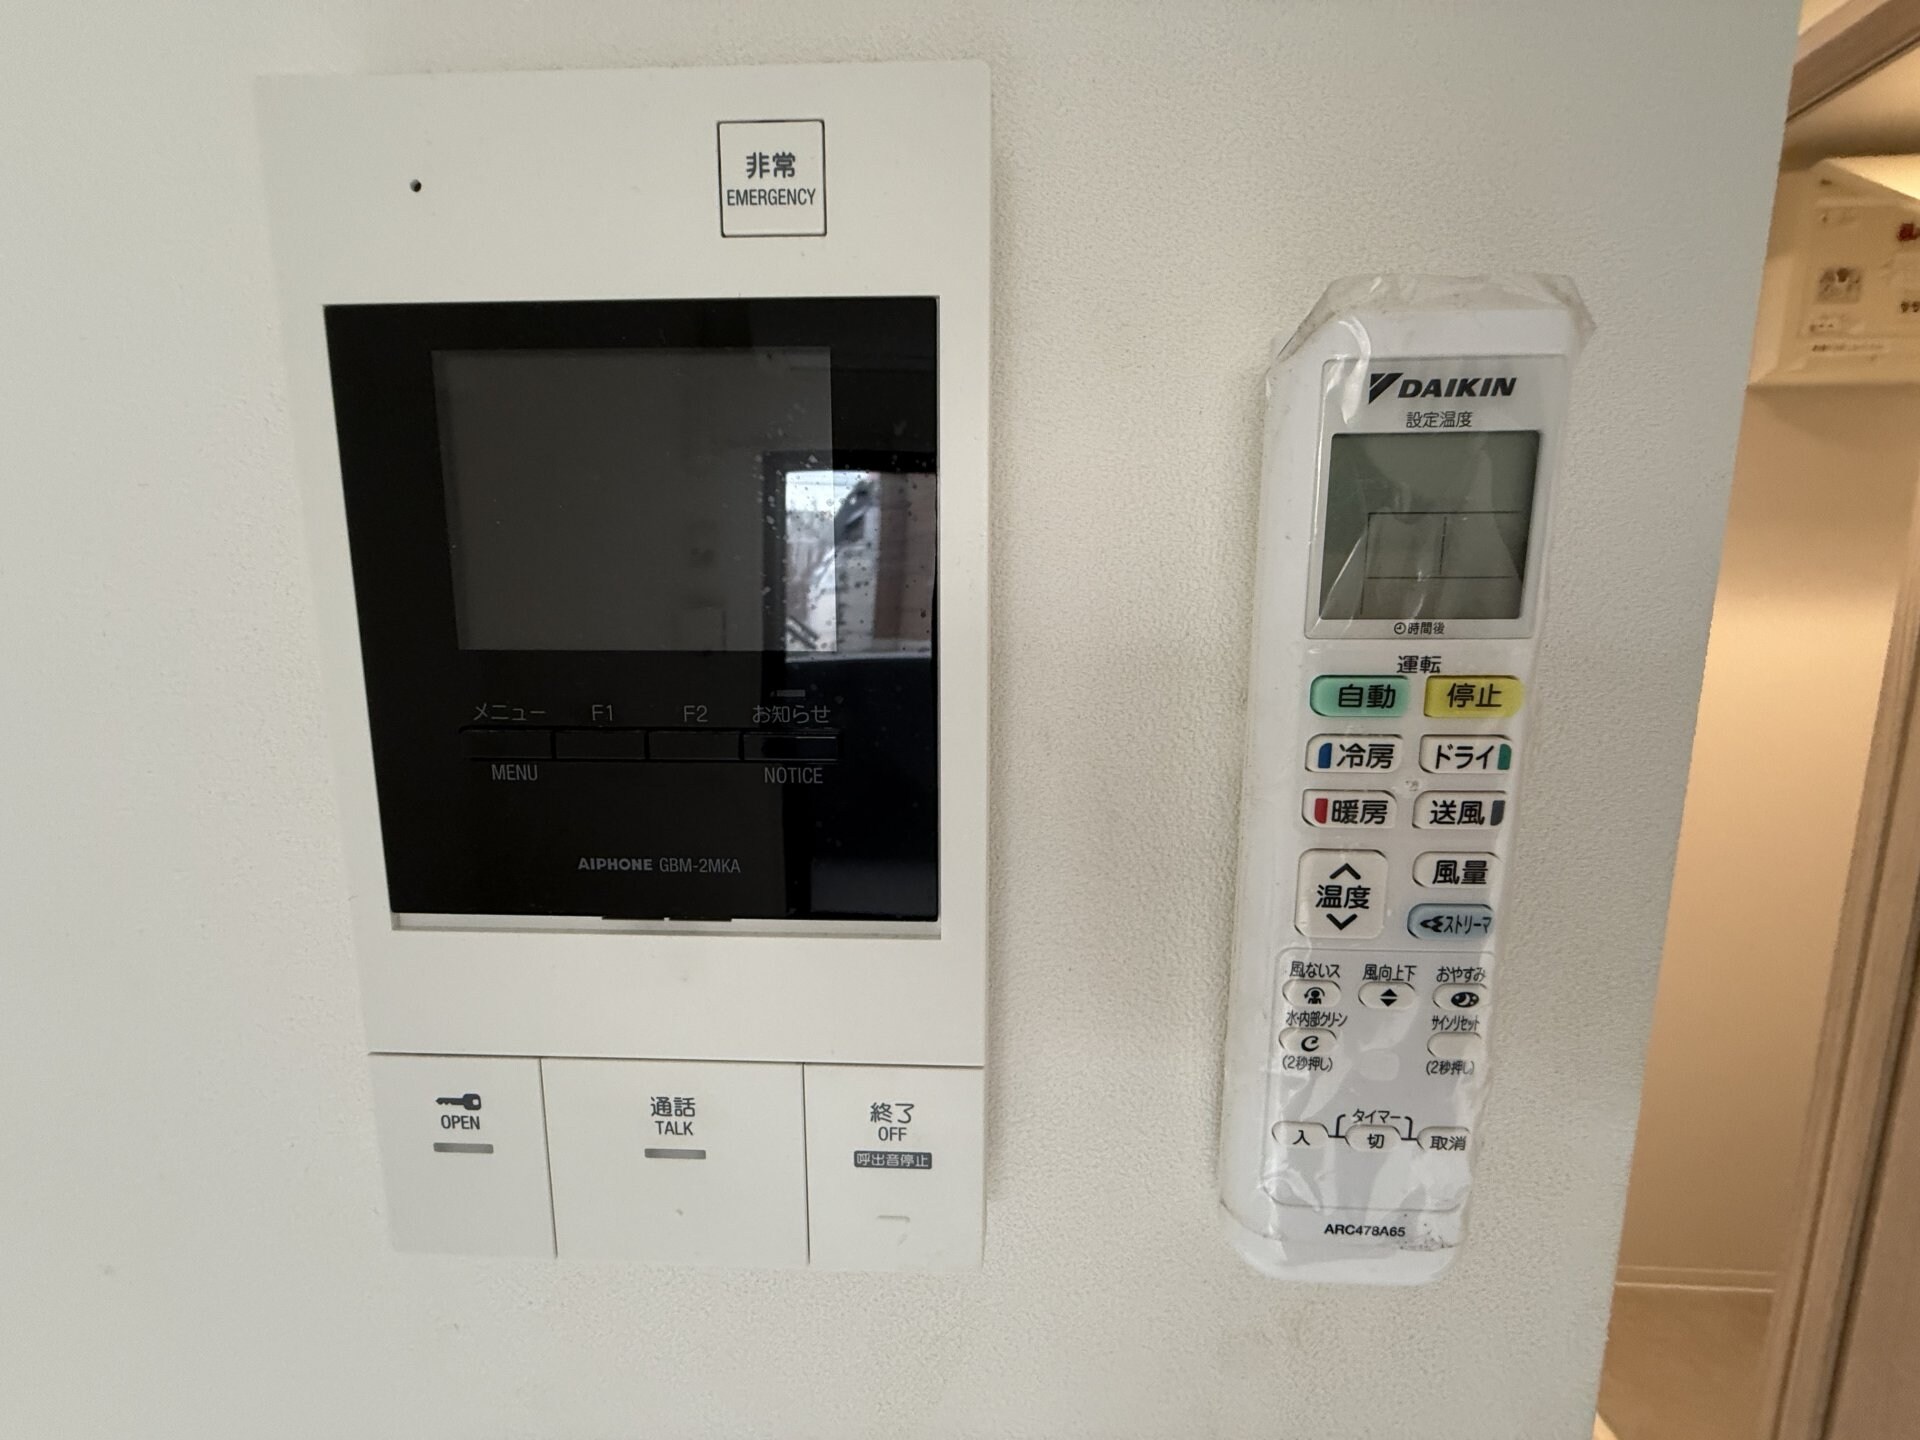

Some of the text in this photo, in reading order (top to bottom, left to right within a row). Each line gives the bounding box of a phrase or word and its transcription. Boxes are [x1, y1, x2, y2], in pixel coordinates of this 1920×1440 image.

[746, 151, 796, 179] 非常
[727, 188, 816, 206] EMERGENCY
[1398, 377, 1517, 398] DAIKIN
[1406, 411, 1473, 429] 設定温度
[1407, 622, 1445, 635] 時間後
[1396, 655, 1442, 674] 運転
[1338, 683, 1396, 709] 自動
[1447, 683, 1502, 708] 停止
[473, 703, 546, 721] メニュー
[591, 704, 614, 721] F1
[682, 705, 709, 722] F2
[752, 704, 831, 724] お知らせ
[1336, 743, 1395, 769] 冷房
[1435, 745, 1494, 770] ドライ
[491, 764, 538, 781] MENU
[764, 767, 824, 784] NOTICE
[1331, 799, 1389, 825] 暖房
[1429, 801, 1485, 826] 送風
[577, 857, 742, 873] AIPHONE GBM-2MKA
[1432, 860, 1488, 885] 風量
[1315, 884, 1371, 909] 温度
[1443, 915, 1492, 934] ストリーマ
[1290, 961, 1341, 978] 風ないス
[1362, 964, 1417, 981] 風向上下
[1436, 966, 1486, 983] おやすみ
[1432, 1015, 1480, 1031] サインリセット
[650, 1097, 696, 1118] 通話
[870, 1102, 915, 1124] 終了
[440, 1115, 480, 1131] OPEN
[1352, 1109, 1401, 1124] タイマー
[655, 1121, 694, 1136] TALK
[878, 1126, 907, 1141] OFF
[1292, 1130, 1311, 1146] 入
[1368, 1134, 1384, 1149] 切
[1430, 1136, 1467, 1151] 取消
[856, 1152, 929, 1168] 呼出音停止
[1324, 1223, 1406, 1238] ARC478A65
